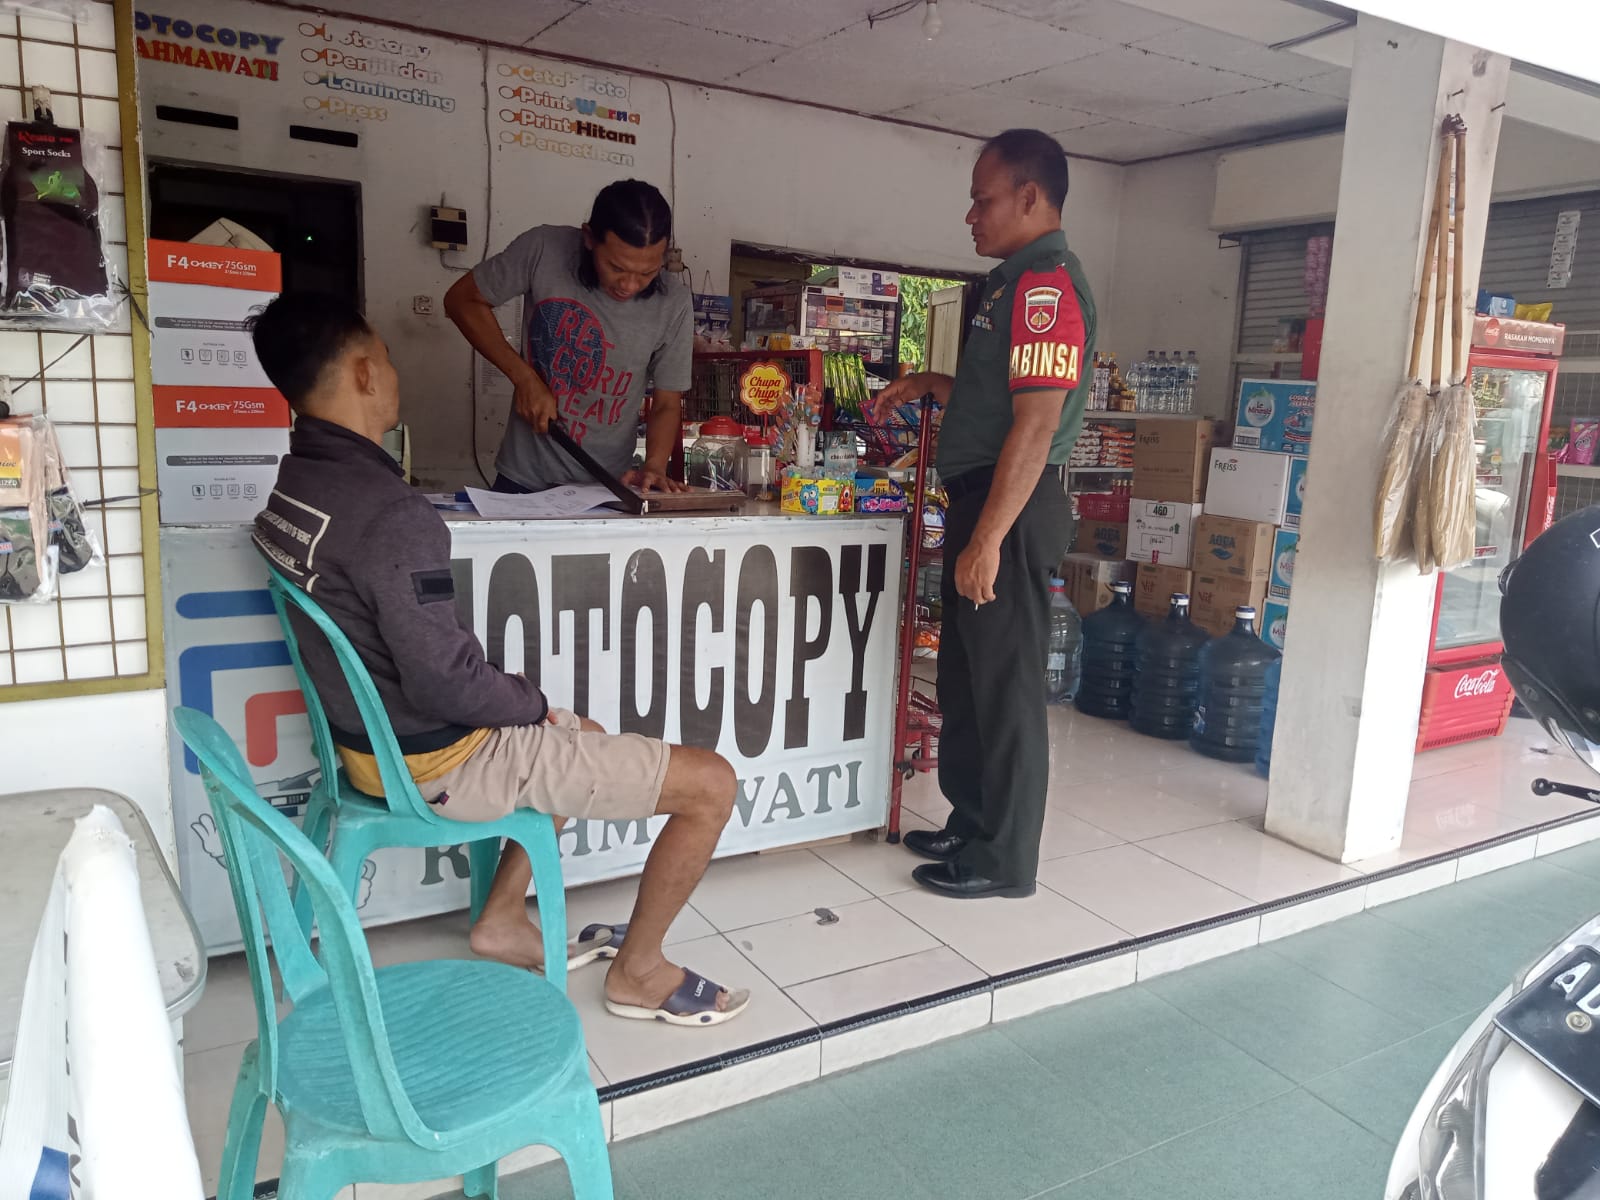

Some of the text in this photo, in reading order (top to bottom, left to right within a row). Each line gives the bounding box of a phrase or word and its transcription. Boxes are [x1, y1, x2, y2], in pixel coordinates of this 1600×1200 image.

[326, 70, 456, 113] Laminating
[520, 86, 575, 111] Print
[328, 96, 388, 121] Press
[520, 109, 637, 145] Print Hitam
[22, 146, 72, 158] Sport Socks
[167, 254, 189, 269] F4
[750, 376, 781, 389] Chupa
[175, 400, 198, 413] F4
[748, 386, 780, 405] Chups
[451, 544, 887, 757] OTOCOPY
